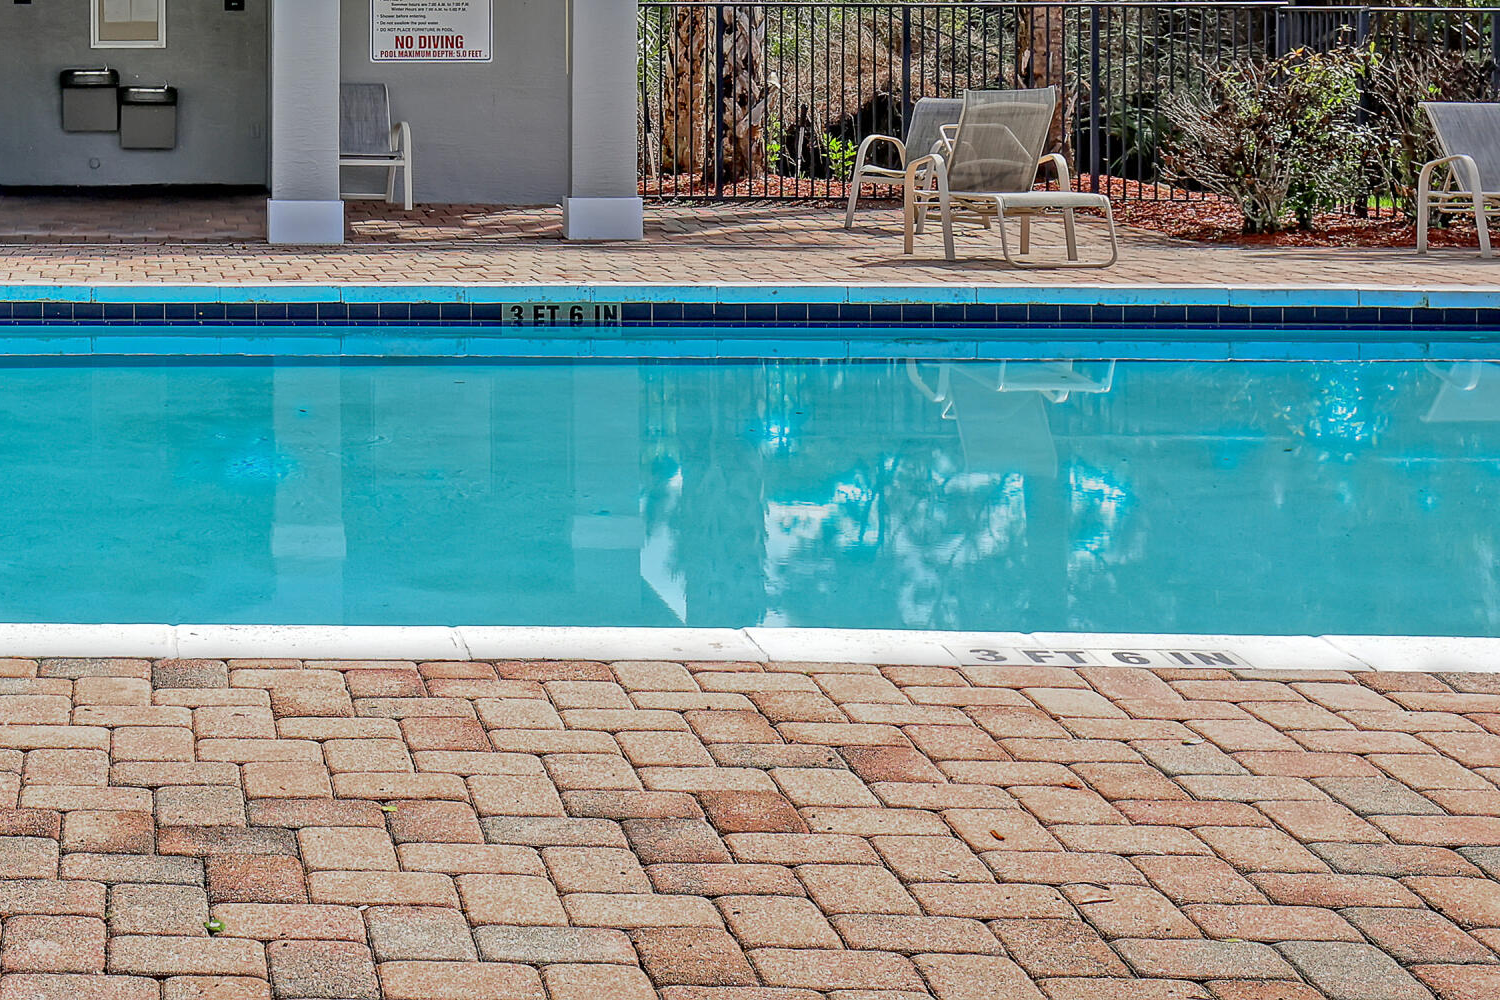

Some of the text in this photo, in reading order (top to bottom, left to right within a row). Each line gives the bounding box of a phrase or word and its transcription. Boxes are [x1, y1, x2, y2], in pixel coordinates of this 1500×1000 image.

[395, 35, 464, 49] NO DIVING
[510, 305, 618, 322] 3 FT 6 IN
[970, 650, 1238, 666] 3 FT 6 IN
